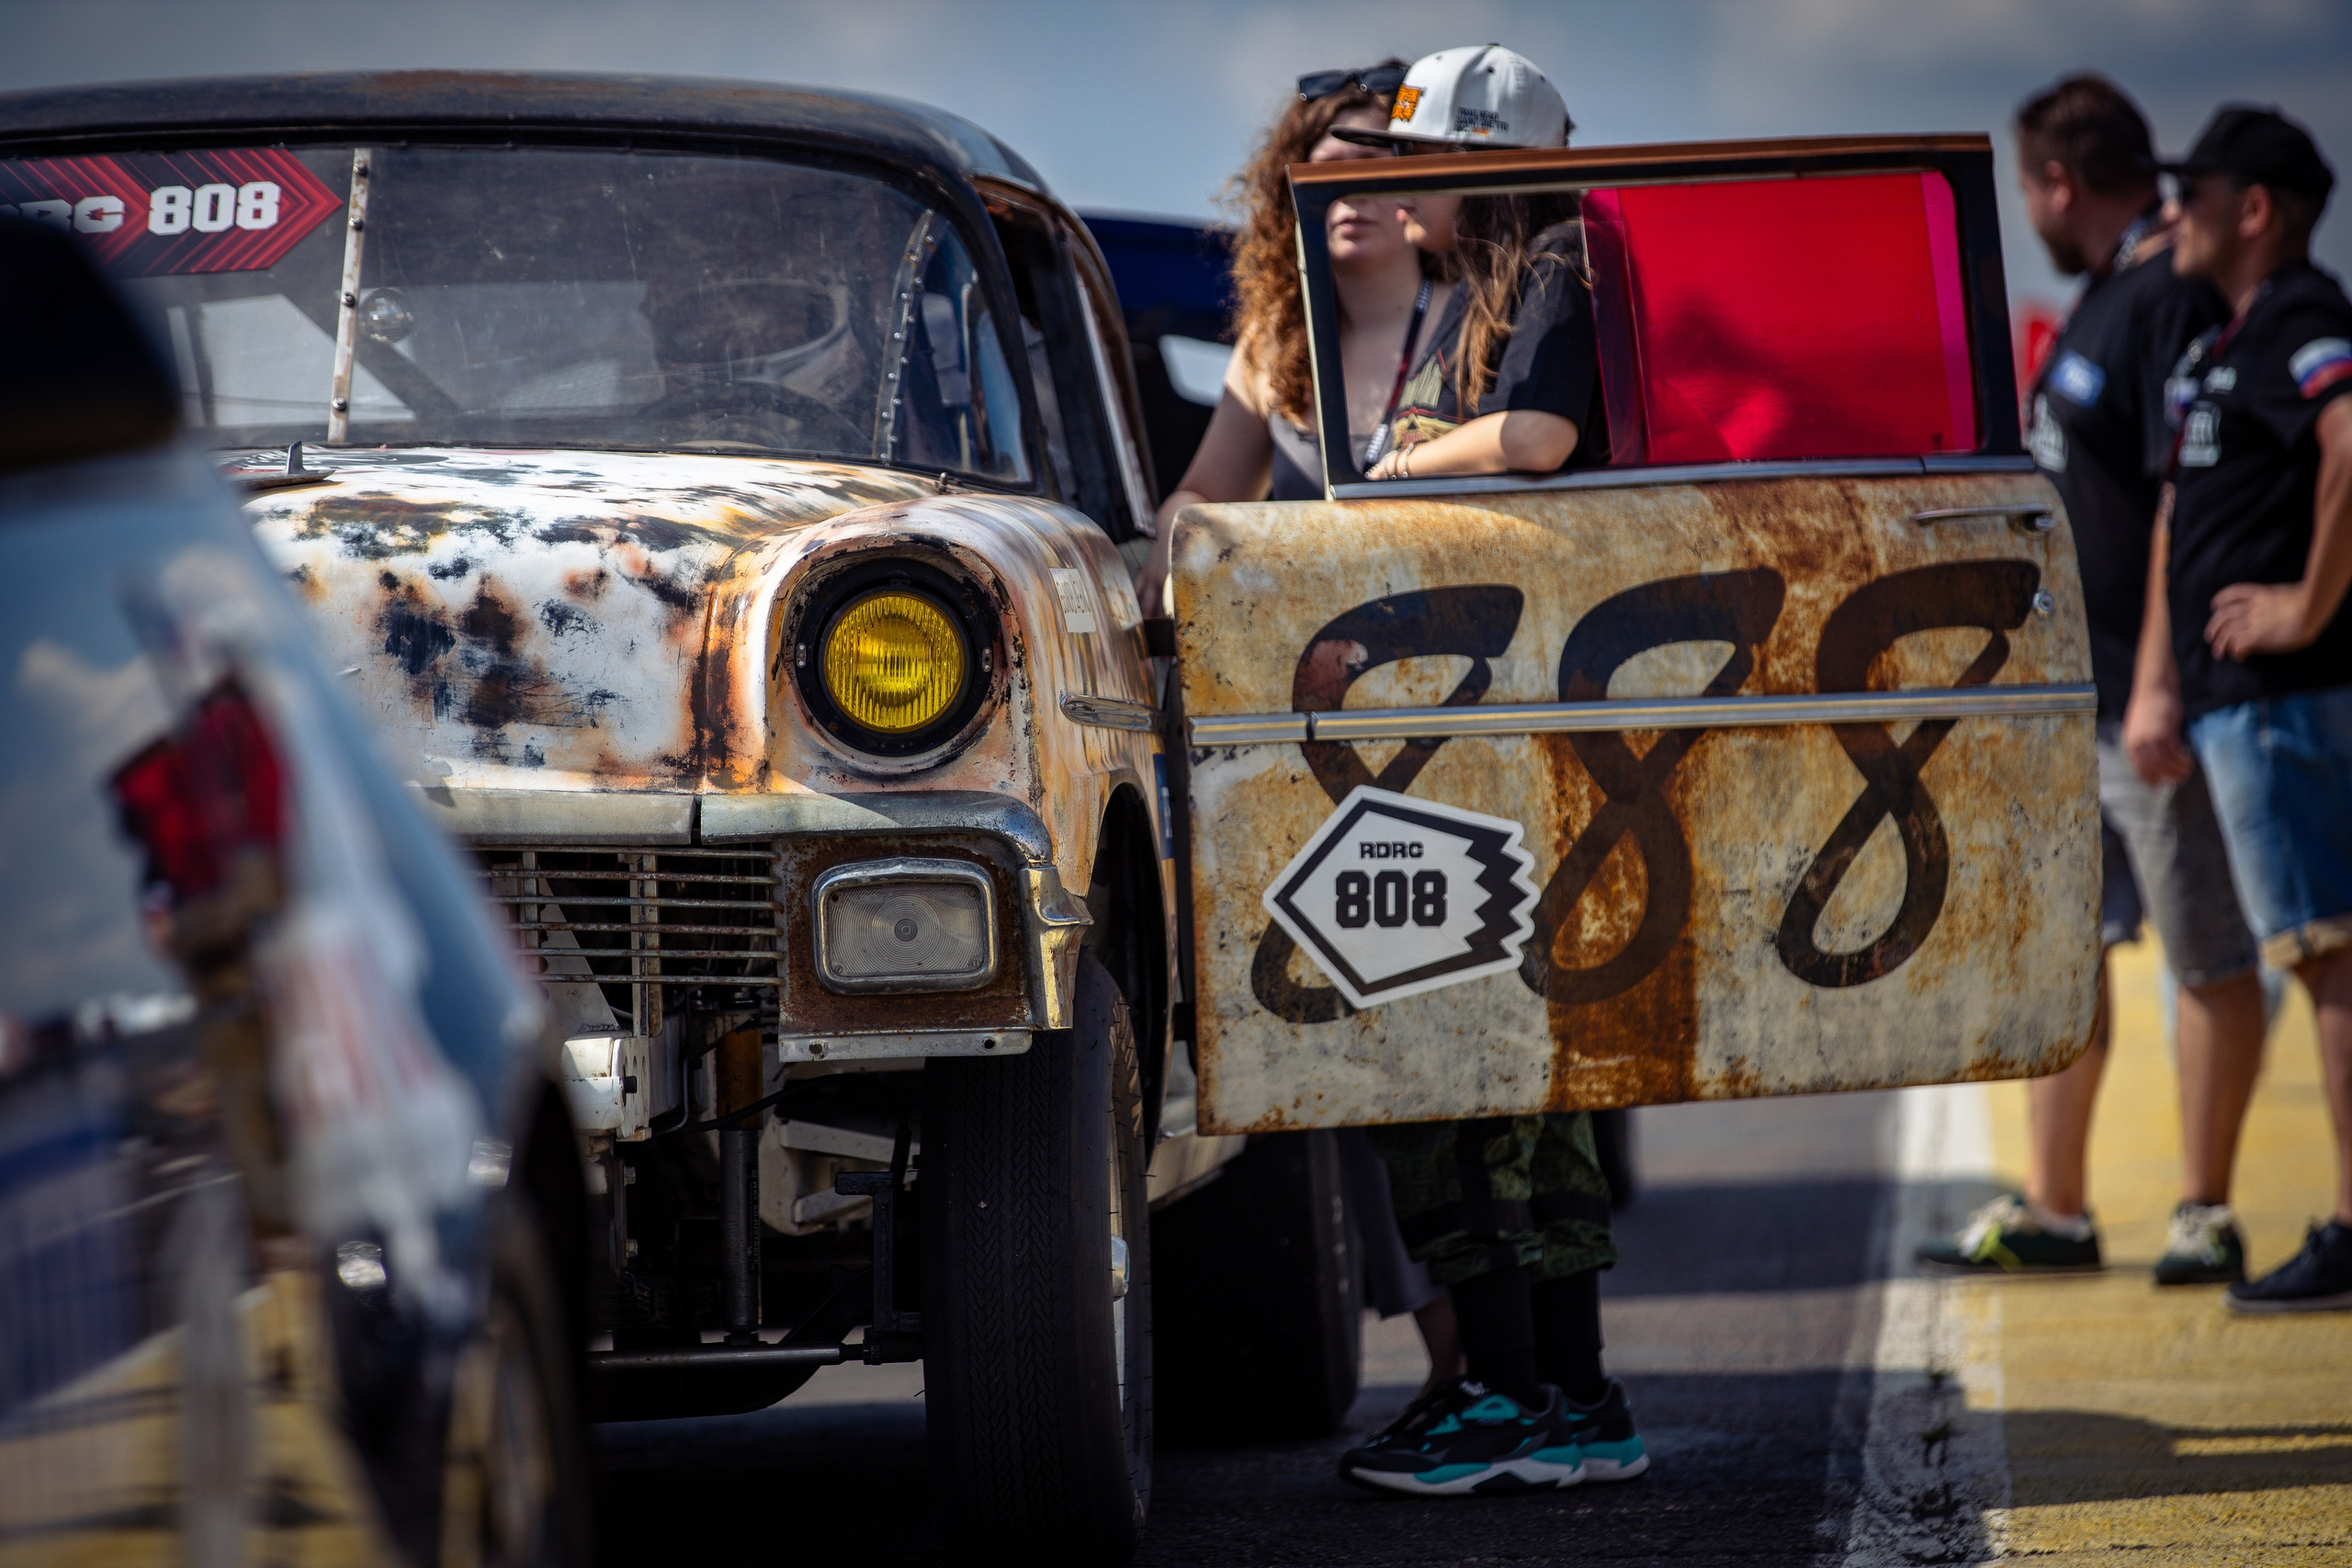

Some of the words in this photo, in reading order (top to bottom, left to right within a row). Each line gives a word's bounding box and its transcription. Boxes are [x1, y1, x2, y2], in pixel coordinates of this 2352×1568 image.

[0, 195, 126, 233] RC
[148, 181, 280, 236] 808
[1360, 841, 1424, 859] RDRC
[1336, 869, 1448, 929] 808
